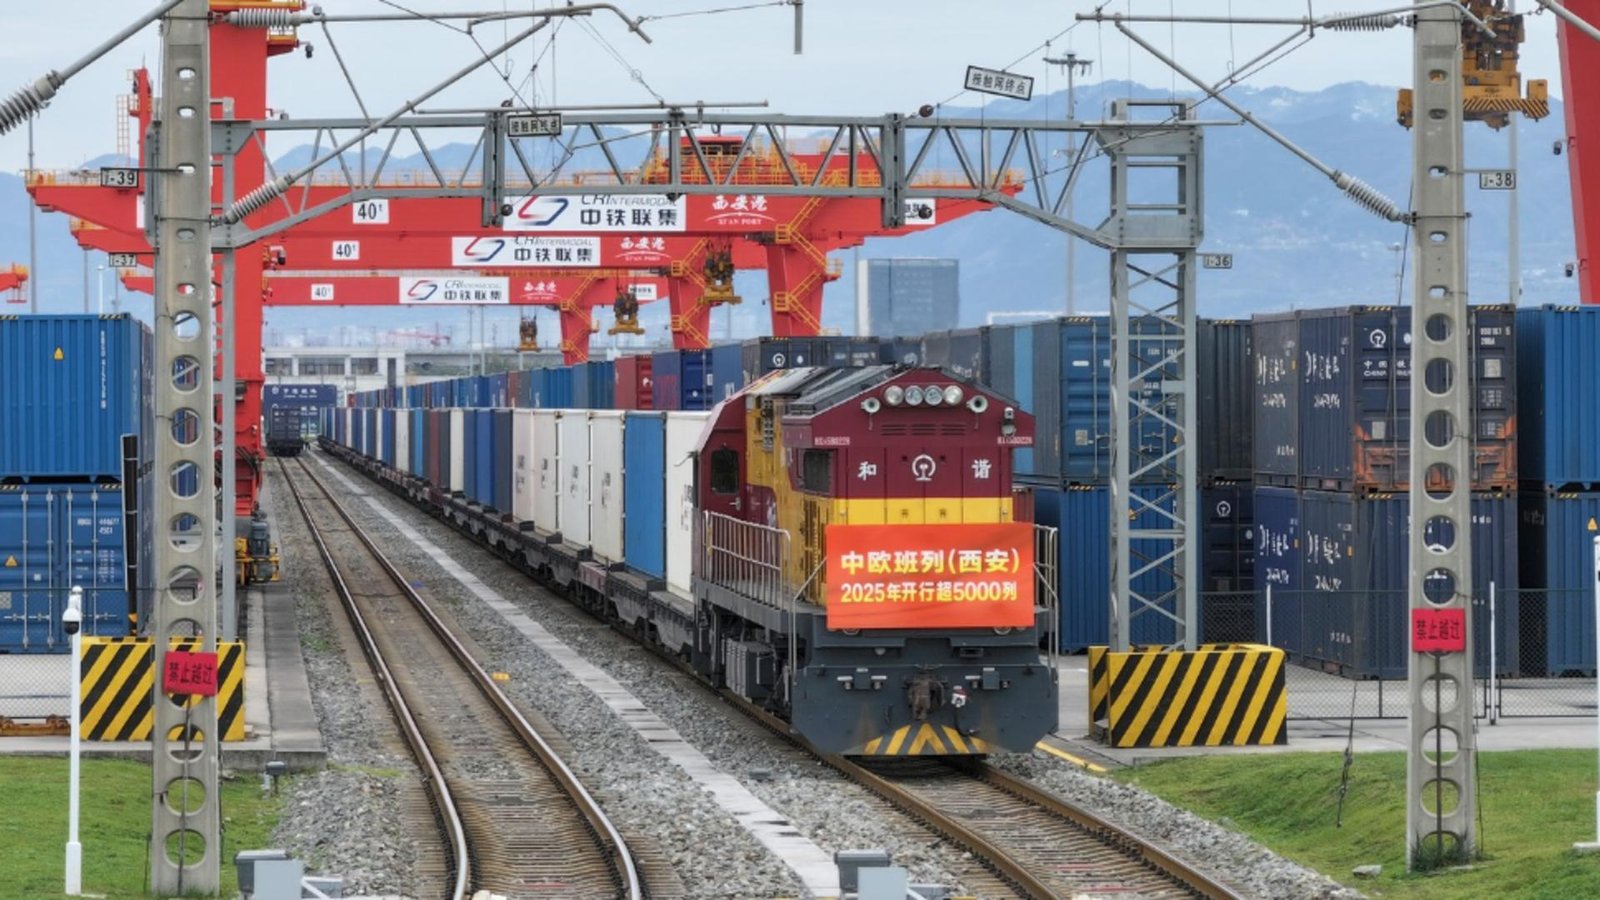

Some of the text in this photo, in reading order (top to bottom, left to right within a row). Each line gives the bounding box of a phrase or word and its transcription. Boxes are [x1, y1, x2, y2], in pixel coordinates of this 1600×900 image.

[972, 73, 1026, 95] 接触网终点
[511, 118, 557, 133] 接触网终点
[712, 195, 768, 212] 西安港
[580, 208, 678, 227] 中铁联集
[741, 218, 762, 226] PORT
[514, 248, 593, 262] 中铁联集
[444, 289, 502, 301] 中铁联集
[1363, 360, 1411, 369] 中国铁
[857, 458, 992, 481] 和 谐
[841, 581, 1018, 603] 2025年开行超5000列
[1416, 619, 1461, 640] 禁止越过
[168, 661, 213, 685] 禁止越过
